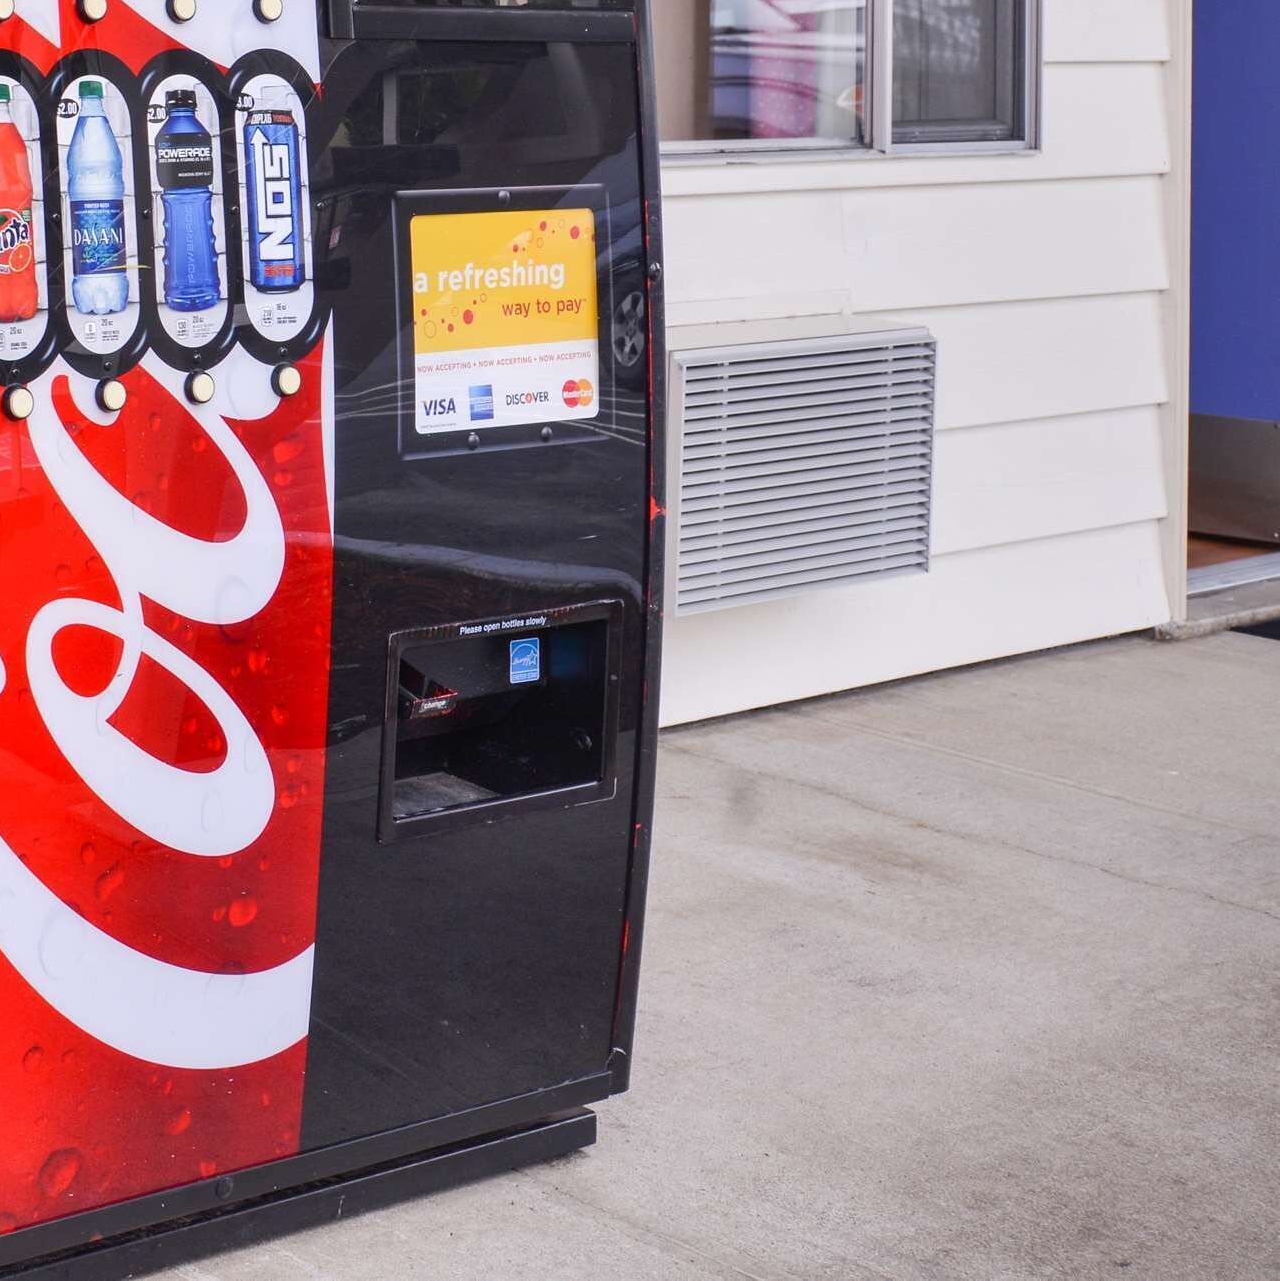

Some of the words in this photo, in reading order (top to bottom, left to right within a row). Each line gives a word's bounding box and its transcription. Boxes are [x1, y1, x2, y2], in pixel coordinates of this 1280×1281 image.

[158, 147, 211, 159] POWERADE
[252, 143, 294, 261] NOS
[74, 222, 123, 248] DASANI
[415, 272, 428, 293] a
[438, 259, 566, 293] refreshing
[502, 302, 530, 318] way
[536, 299, 551, 314] to
[556, 299, 582, 315] pay
[435, 362, 472, 372] ACCEPTING
[478, 360, 495, 368] NOW
[496, 356, 532, 366] ACCEPTING
[539, 354, 555, 362] NOW
[556, 350, 592, 361] ACCEPTING
[423, 398, 457, 416] VISA
[505, 391, 550, 406] DISCOVER
[459, 624, 482, 635] Please
[483, 622, 501, 633] open
[501, 618, 525, 629] bottles
[525, 615, 547, 626] slowly
